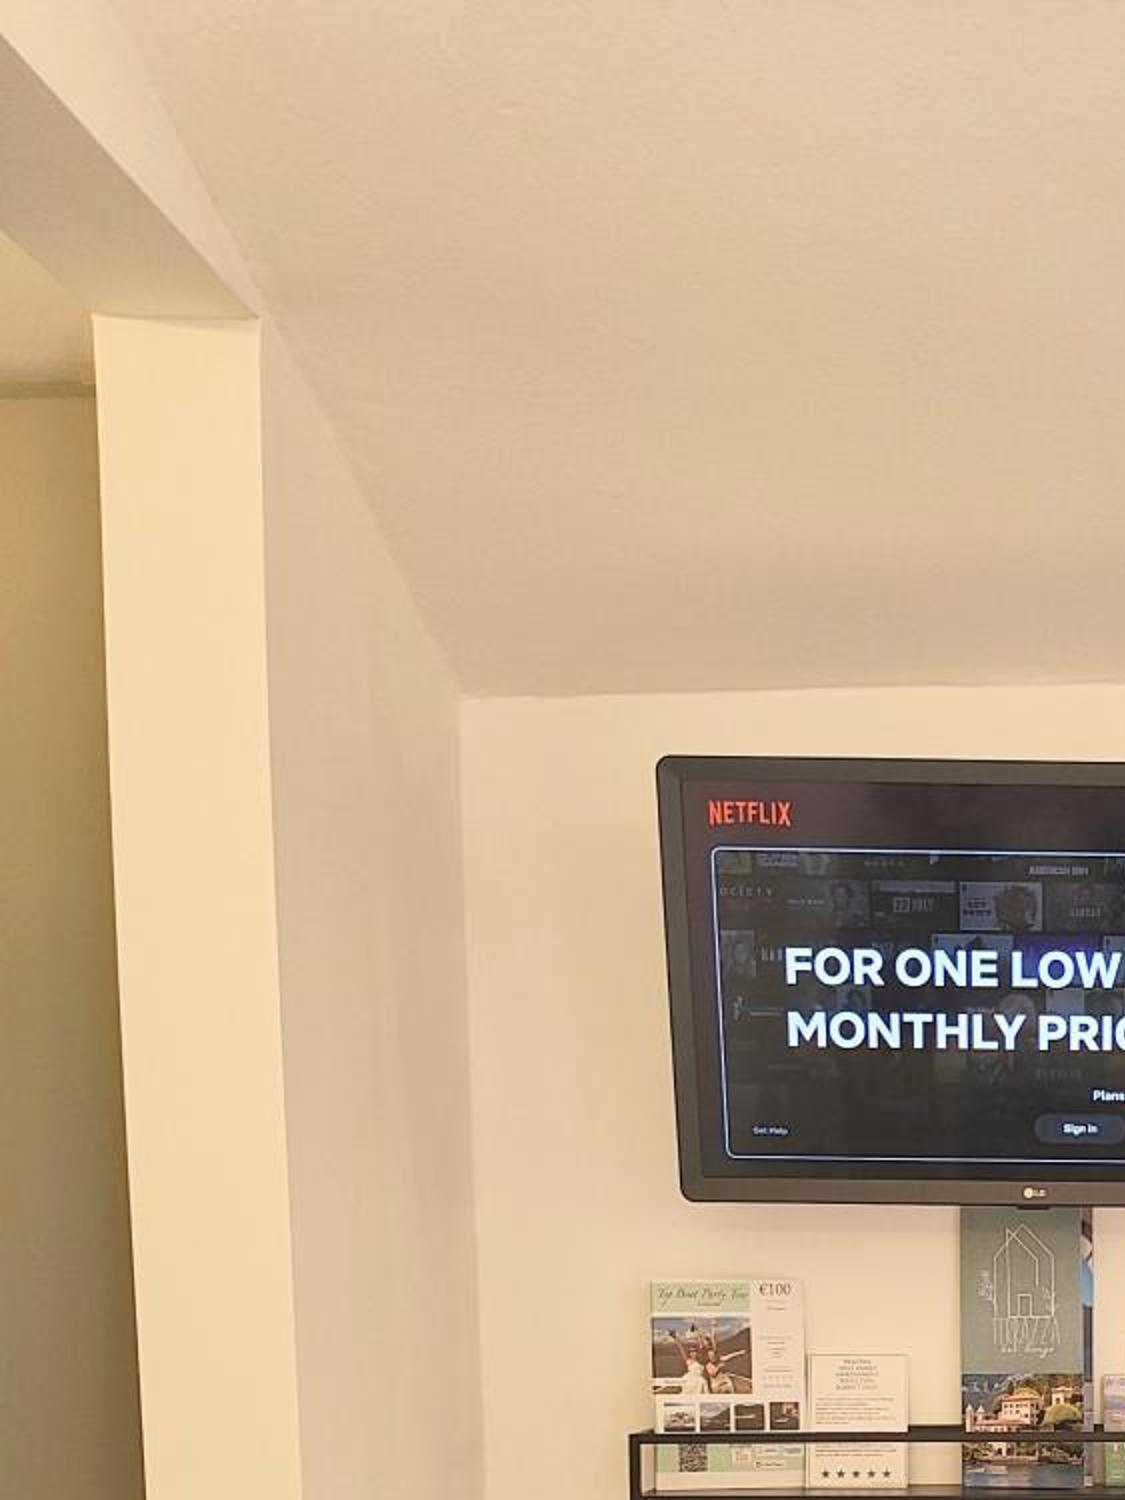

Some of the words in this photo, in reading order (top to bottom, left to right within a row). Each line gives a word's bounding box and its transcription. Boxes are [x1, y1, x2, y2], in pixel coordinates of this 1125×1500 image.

[708, 800, 792, 826] NETFLIX
[785, 947, 885, 986] FOR
[895, 949, 999, 987] ONE
[1011, 951, 1123, 989] LOW
[787, 1011, 1027, 1051] MONTHLY
[1093, 1090, 1125, 1101] Plans
[1063, 1123, 1087, 1136] Sign
[1088, 1123, 1098, 1134] in
[759, 1283, 792, 1297] €100
